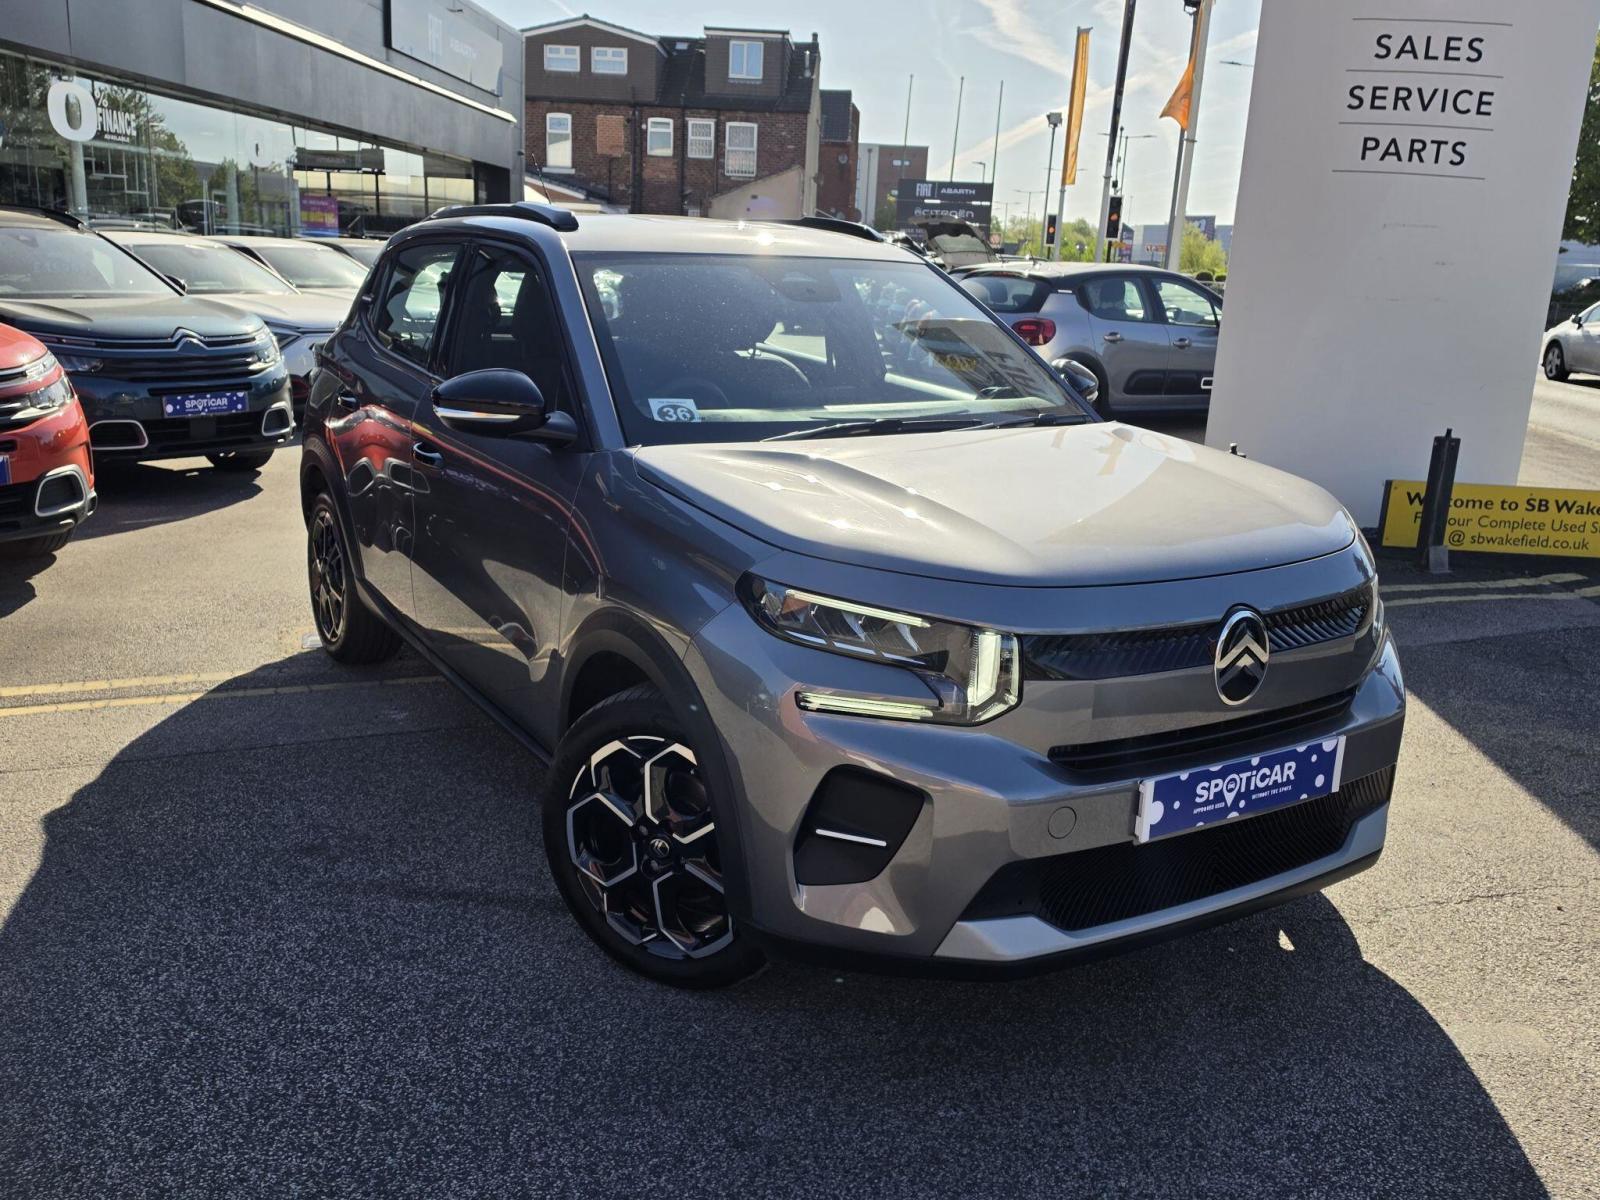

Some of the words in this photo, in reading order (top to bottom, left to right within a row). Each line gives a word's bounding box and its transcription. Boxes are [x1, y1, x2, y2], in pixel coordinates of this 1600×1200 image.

[1374, 34, 1485, 63] SALES
[1347, 85, 1495, 116] SERVICE
[97, 107, 136, 137] FINANCE
[1361, 136, 1467, 166] PARTS
[916, 183, 932, 197] FIAT
[940, 187, 976, 195] ABARTH
[662, 407, 691, 421] 36
[1500, 498, 1519, 512] to
[1525, 498, 1550, 513] SB
[1478, 515, 1546, 533] Complete
[1551, 519, 1586, 534] Used
[1448, 529, 1466, 547] @
[1470, 532, 1589, 550] sbwakefield.co.uk
